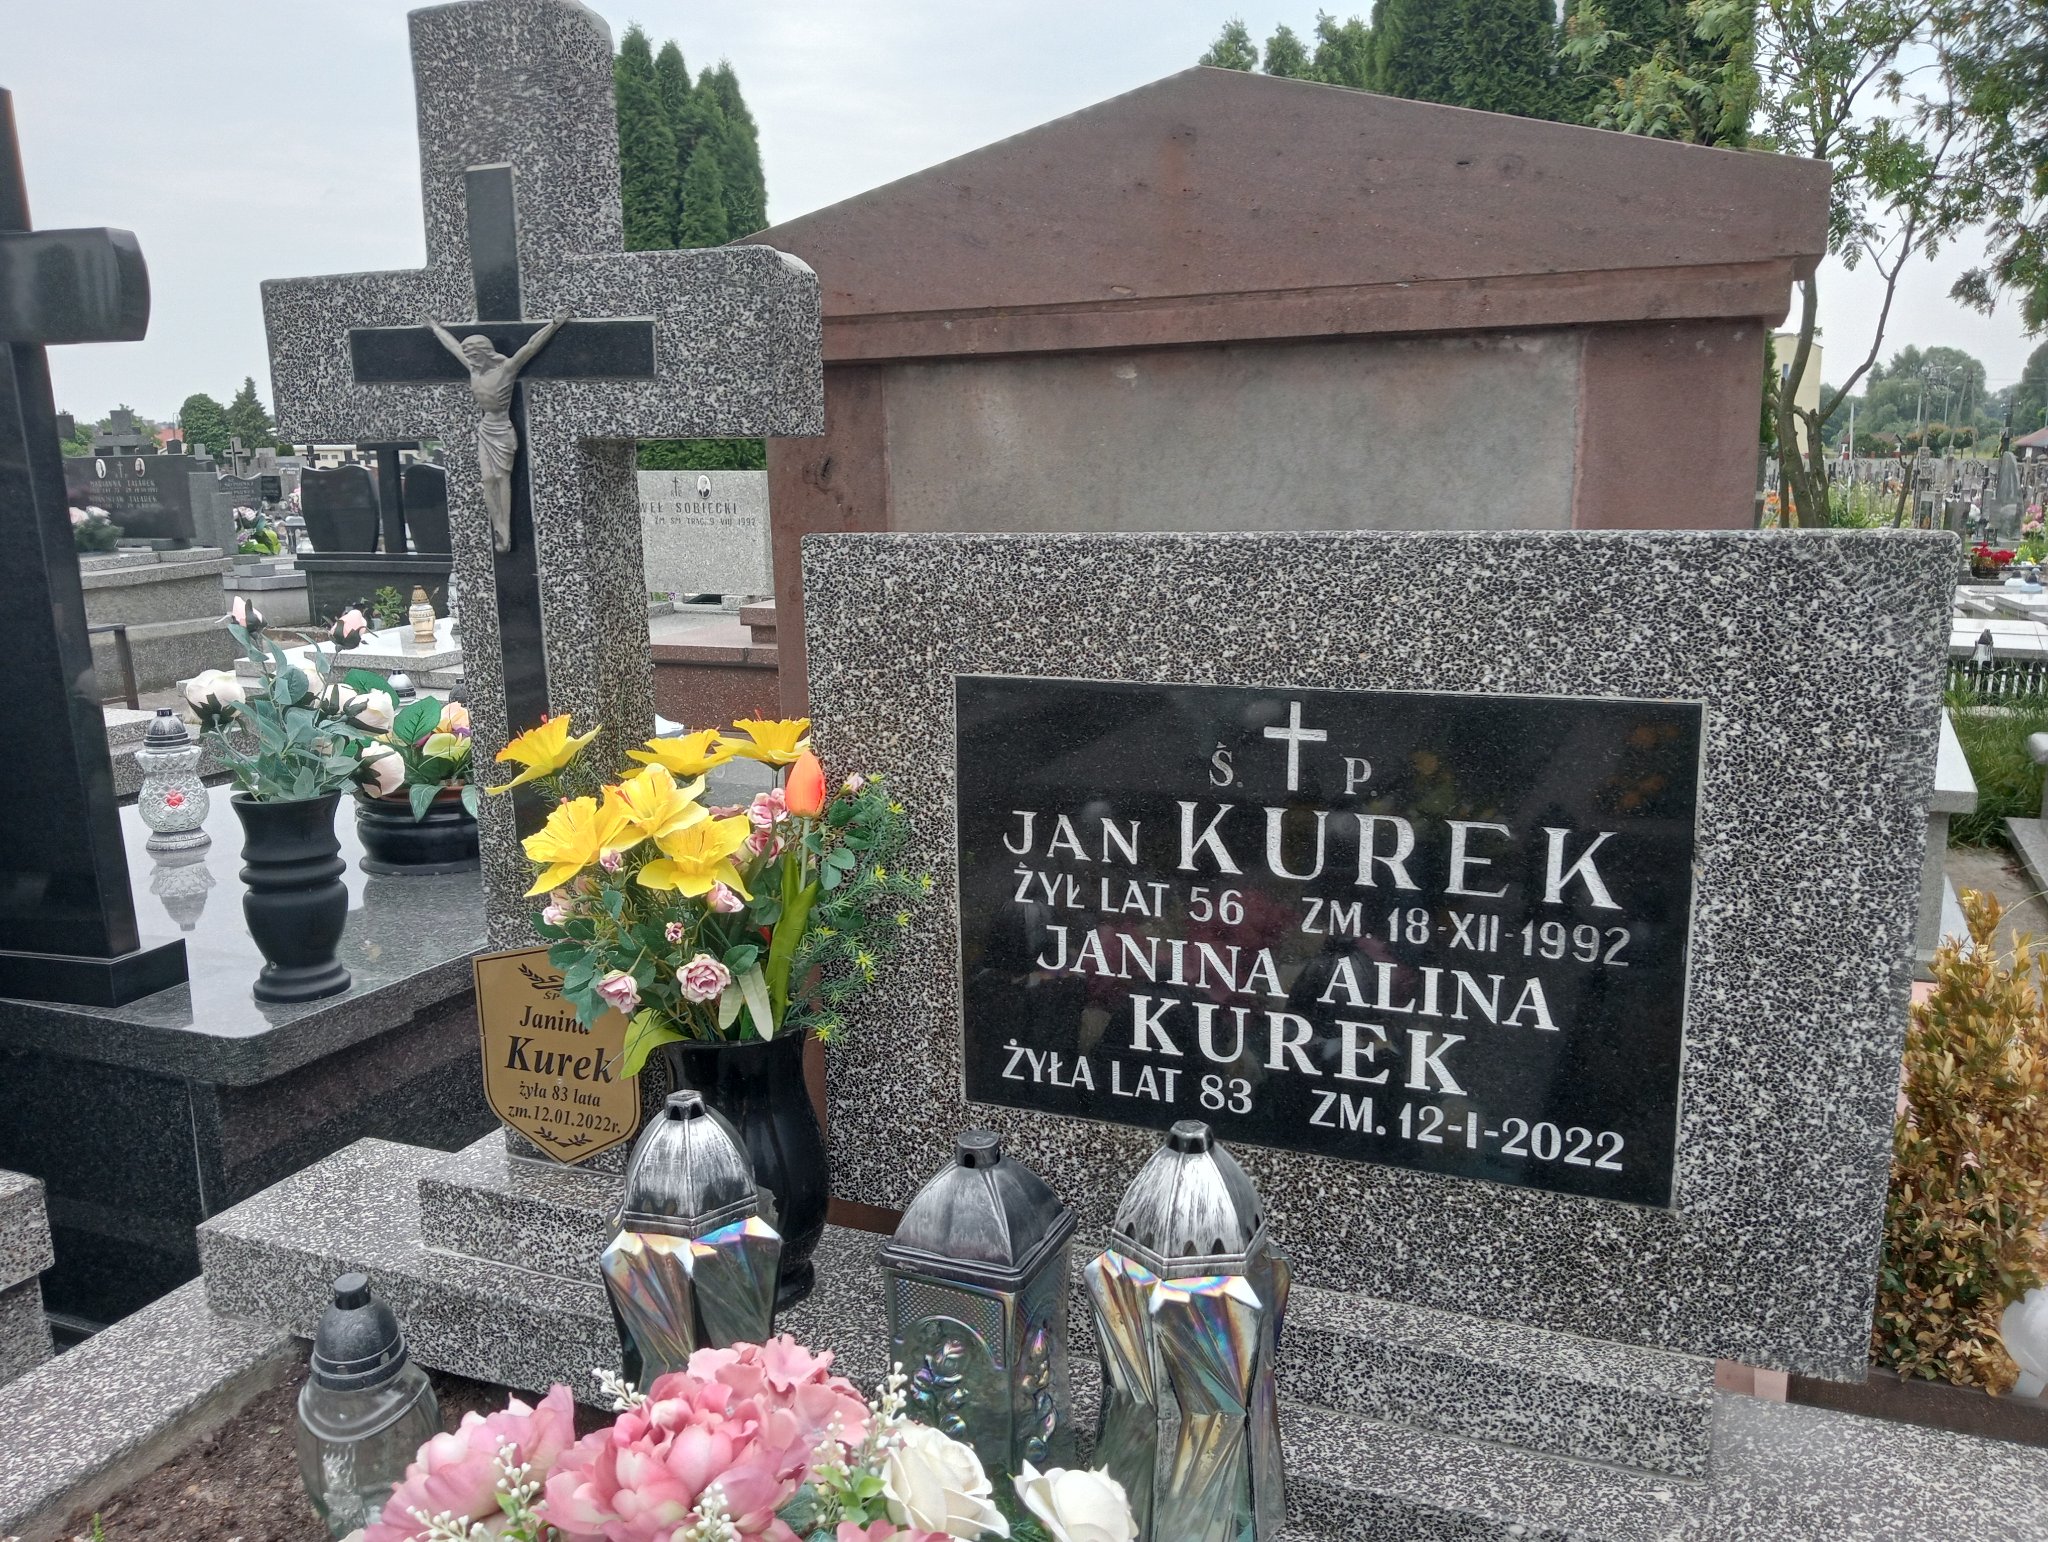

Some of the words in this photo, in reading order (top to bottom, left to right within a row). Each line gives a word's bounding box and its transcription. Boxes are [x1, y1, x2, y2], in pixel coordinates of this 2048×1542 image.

[1003, 810, 1142, 865] JAN
[1176, 800, 1624, 910] KUREK
[1013, 862, 1086, 909] ŻYŁ
[1100, 877, 1171, 918] LAT
[1188, 886, 1245, 926] 56
[1300, 896, 1373, 939] ZM.
[1387, 906, 1631, 967] 18-XII-1992
[1036, 924, 1291, 998] JANINA
[1316, 956, 1561, 1032] ALINA
[503, 1035, 613, 1084] Kurek
[519, 1080, 547, 1099] żyła
[551, 1085, 568, 1102] 83
[573, 1088, 601, 1107] lata
[1129, 993, 1468, 1096] KUREK
[1001, 1037, 1096, 1092] ŻYŁA
[1111, 1060, 1184, 1103] LAT
[1198, 1073, 1254, 1115] 83
[1308, 1089, 1387, 1136] ZM.
[1398, 1102, 1625, 1172] 12-I-2022
